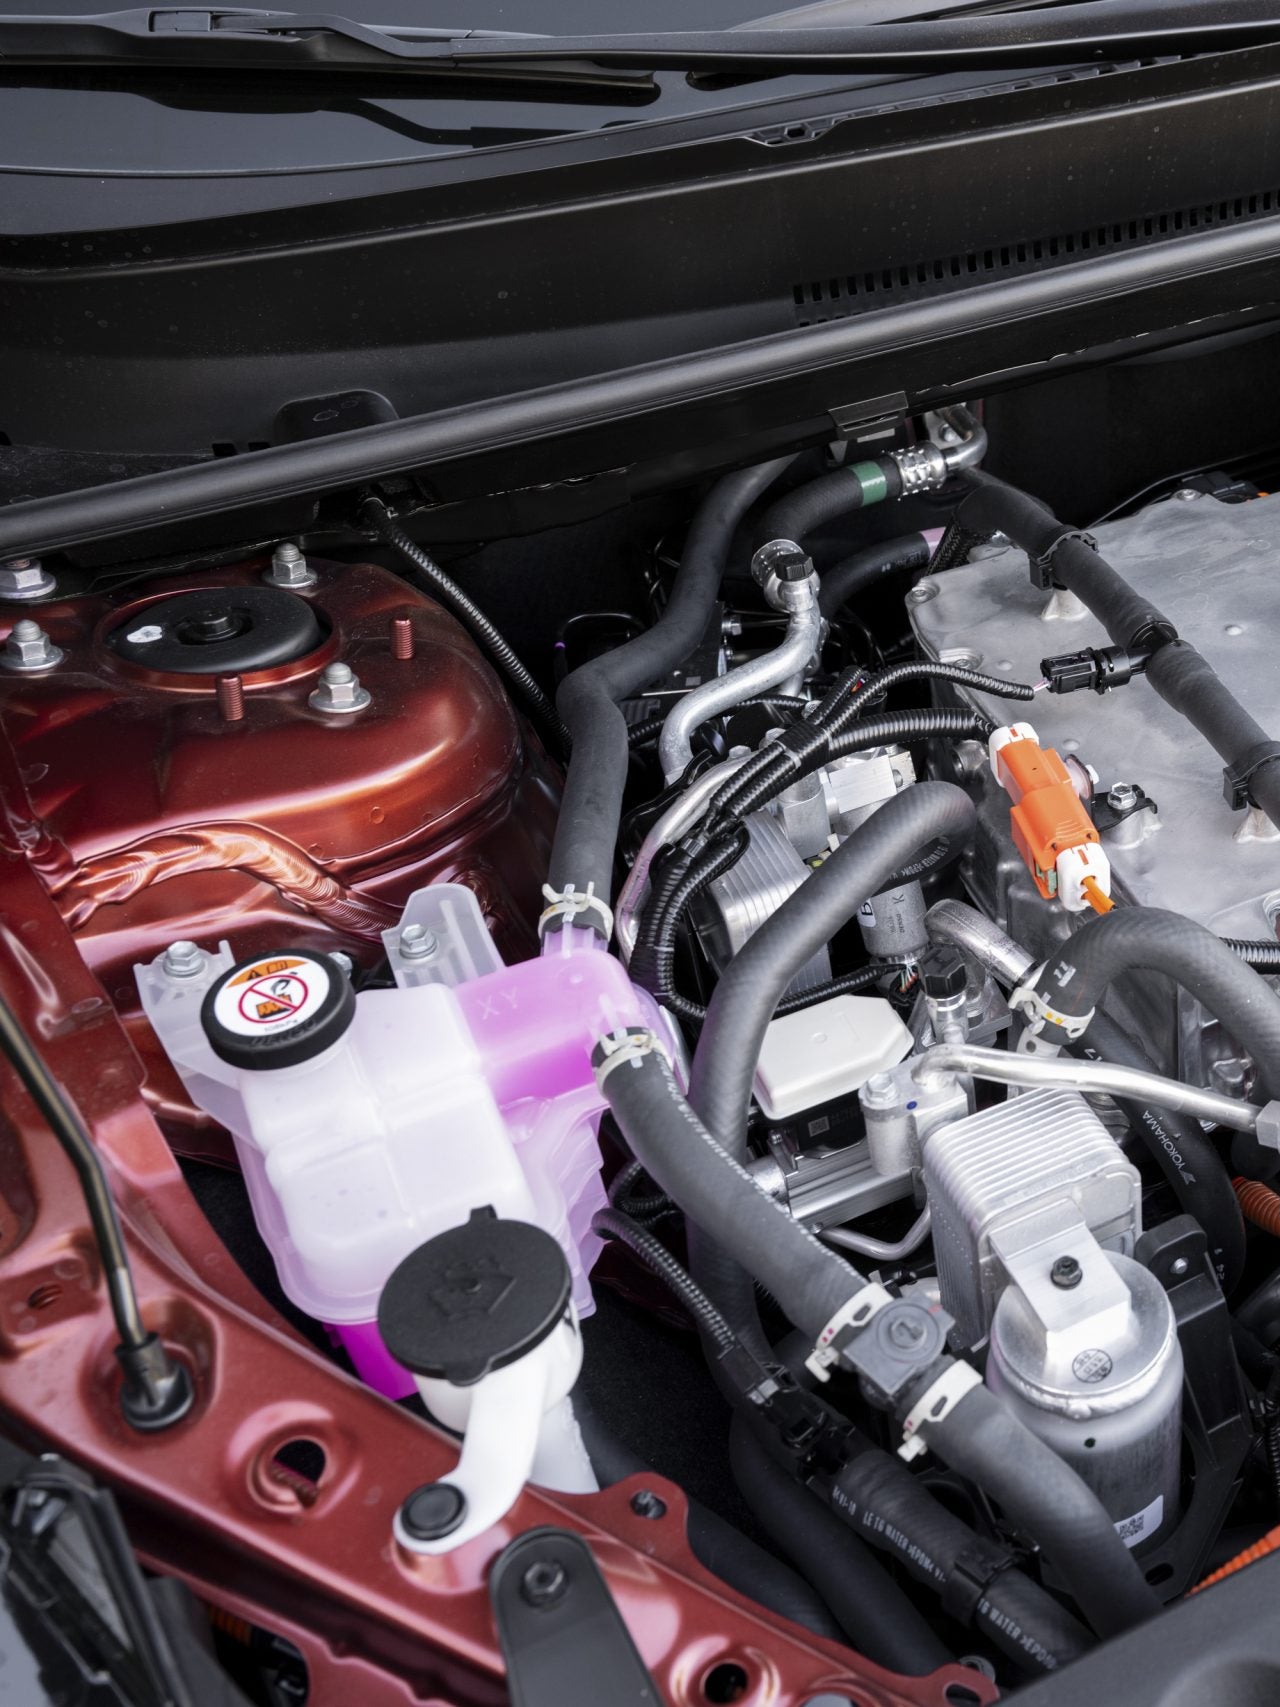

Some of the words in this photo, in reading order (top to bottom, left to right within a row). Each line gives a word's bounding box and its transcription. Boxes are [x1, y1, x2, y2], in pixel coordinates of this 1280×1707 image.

[1142, 1109, 1186, 1170] YOKOHAMA
[862, 1511, 873, 1527] LE
[884, 1524, 908, 1550] WATER
[988, 1604, 1022, 1640] WATER
